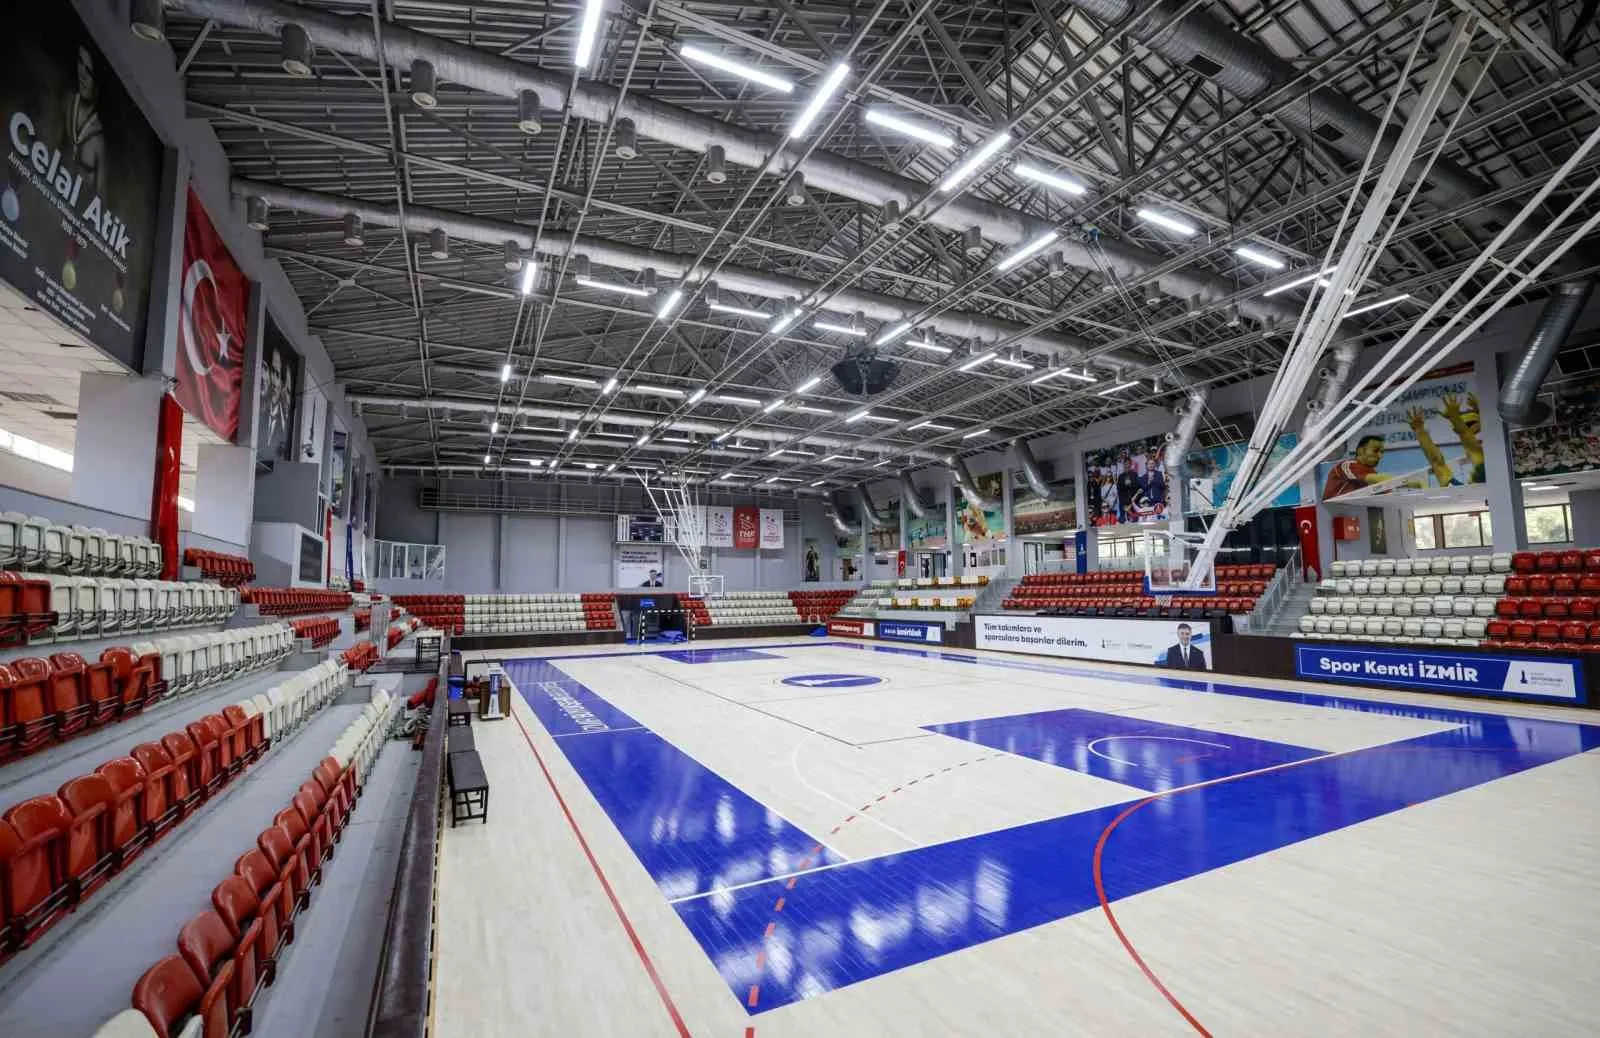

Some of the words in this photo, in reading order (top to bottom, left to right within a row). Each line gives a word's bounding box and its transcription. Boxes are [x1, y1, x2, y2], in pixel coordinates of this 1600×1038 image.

[10, 111, 83, 208] Celal
[82, 194, 131, 259] Atik
[984, 622, 997, 632] Tüm
[998, 623, 1032, 634] takımlara
[1056, 637, 1088, 648] dilerim.
[1319, 656, 1361, 674] Spor
[1364, 660, 1414, 677] Kenti
[1418, 660, 1479, 682] İZMİR
